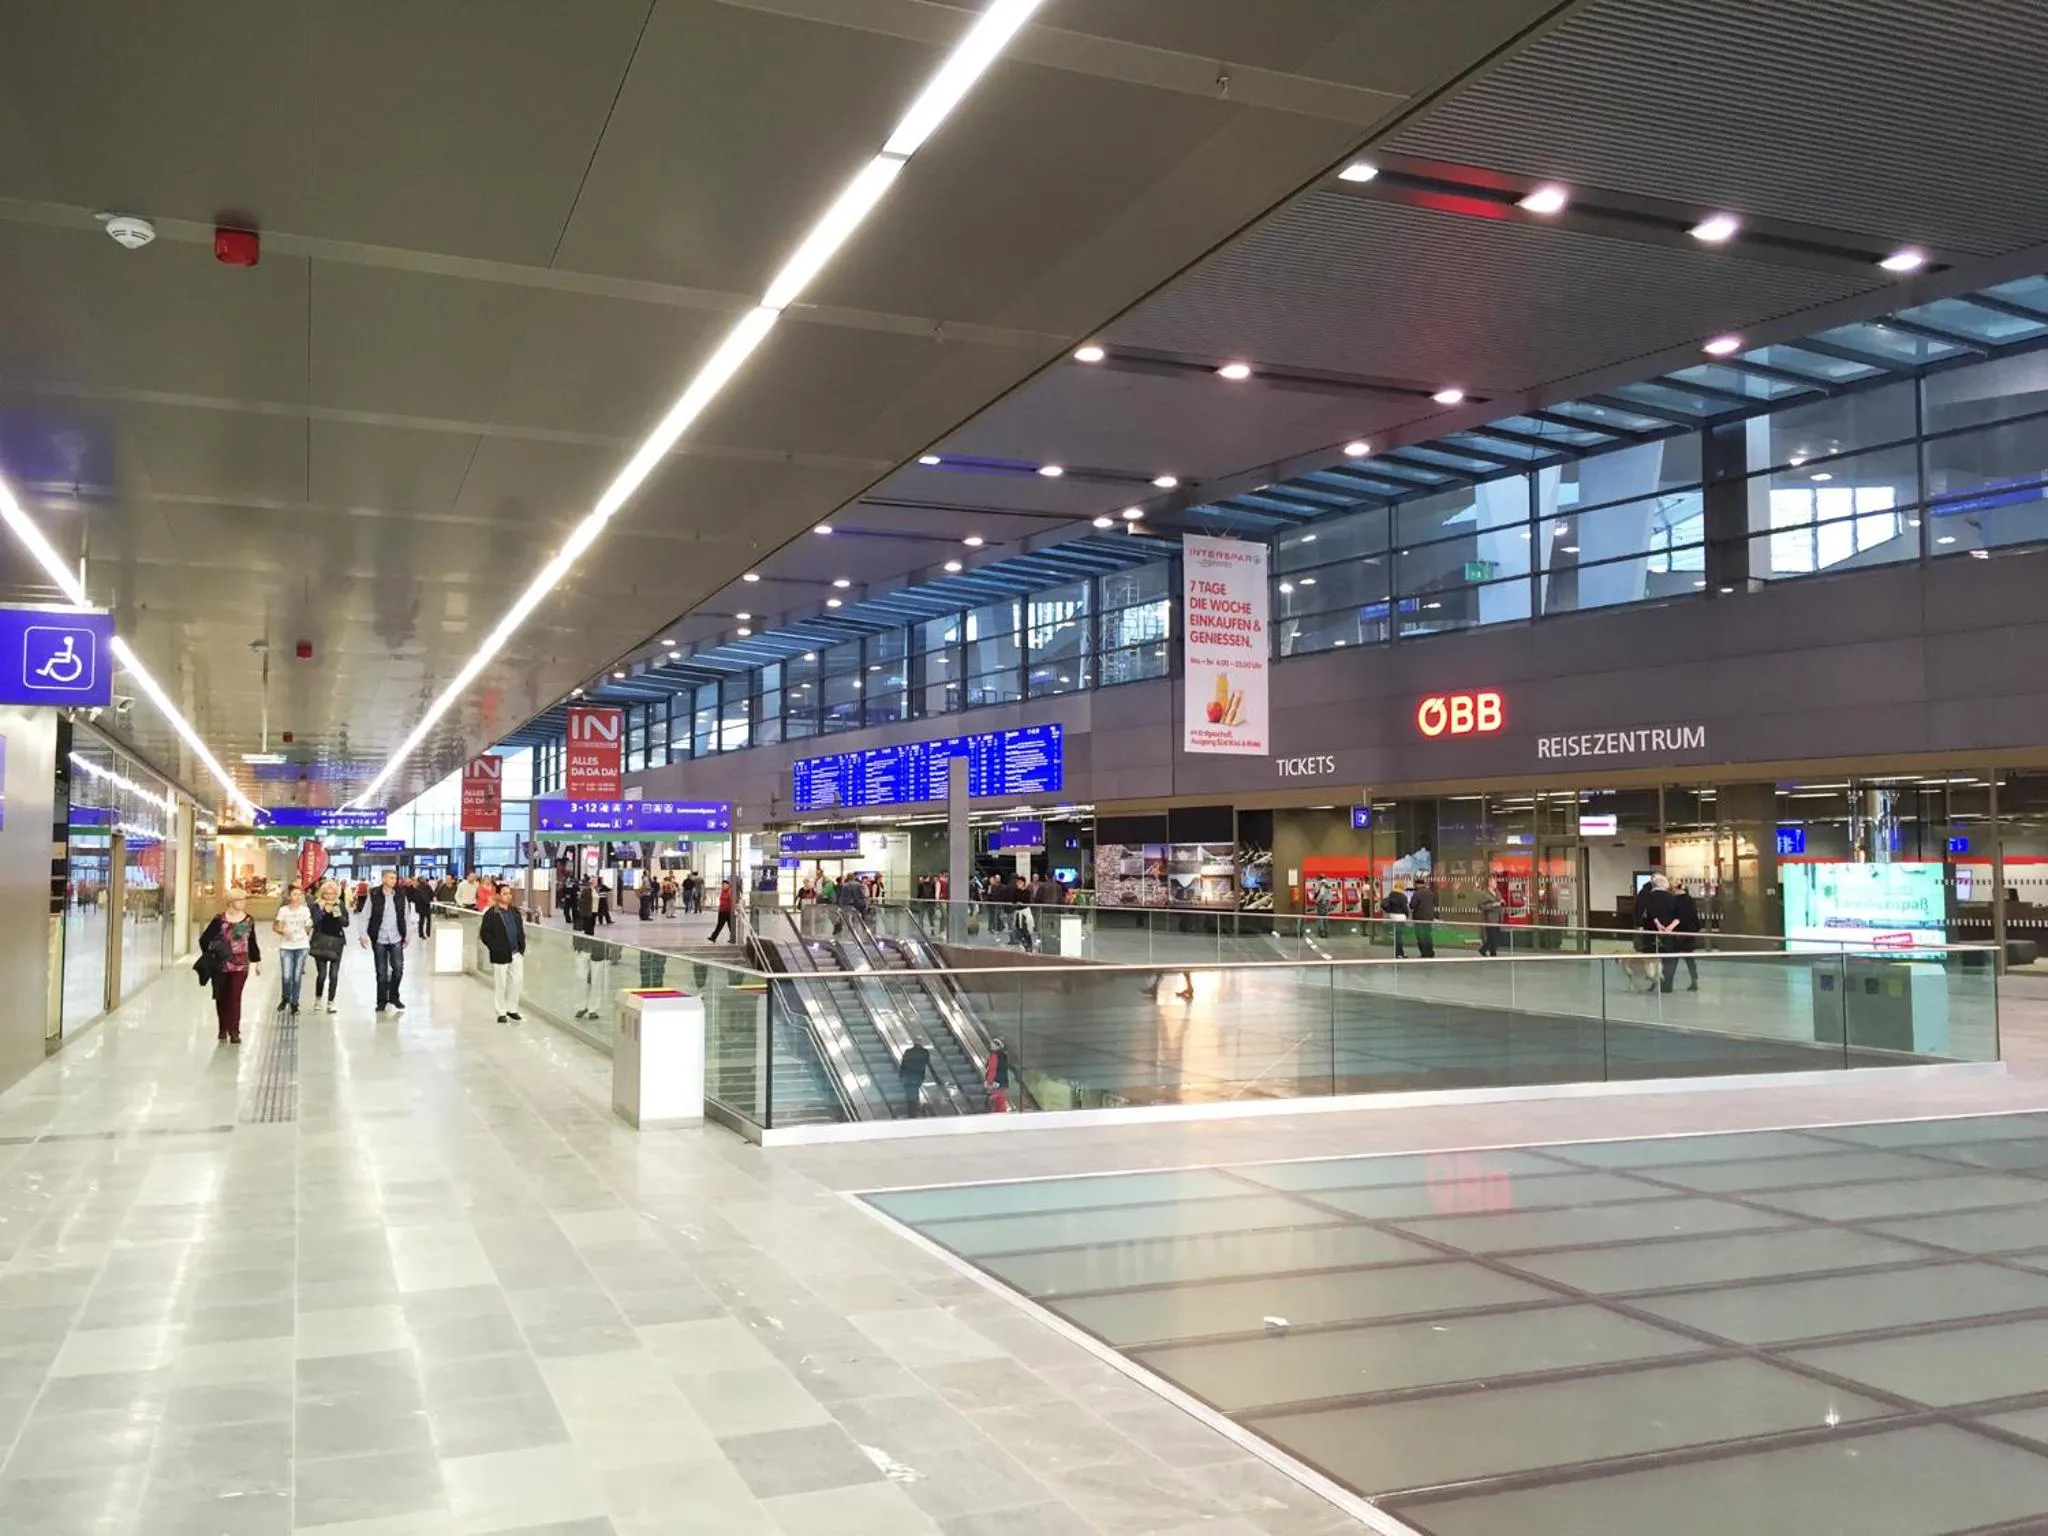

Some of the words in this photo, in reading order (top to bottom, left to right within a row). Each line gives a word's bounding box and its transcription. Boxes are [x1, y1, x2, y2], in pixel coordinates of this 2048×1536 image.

[1190, 581, 1196, 593] 7
[1198, 581, 1227, 596] TAGE
[1190, 597, 1207, 610] DIE
[1210, 600, 1252, 615] WOCHE
[1190, 614, 1251, 631] EINKAUFEN
[1253, 620, 1261, 632] &
[1190, 630, 1252, 648] GENIESSEN.
[1417, 692, 1502, 737] ÖBB
[571, 714, 618, 741] IN
[1537, 725, 1705, 759] REISEZENTRUM
[464, 758, 501, 778] IN
[571, 756, 599, 766] ALLES
[1276, 755, 1335, 777] TICKETS
[571, 767, 585, 776] DA
[586, 767, 600, 776] DA
[601, 767, 618, 776] DA!
